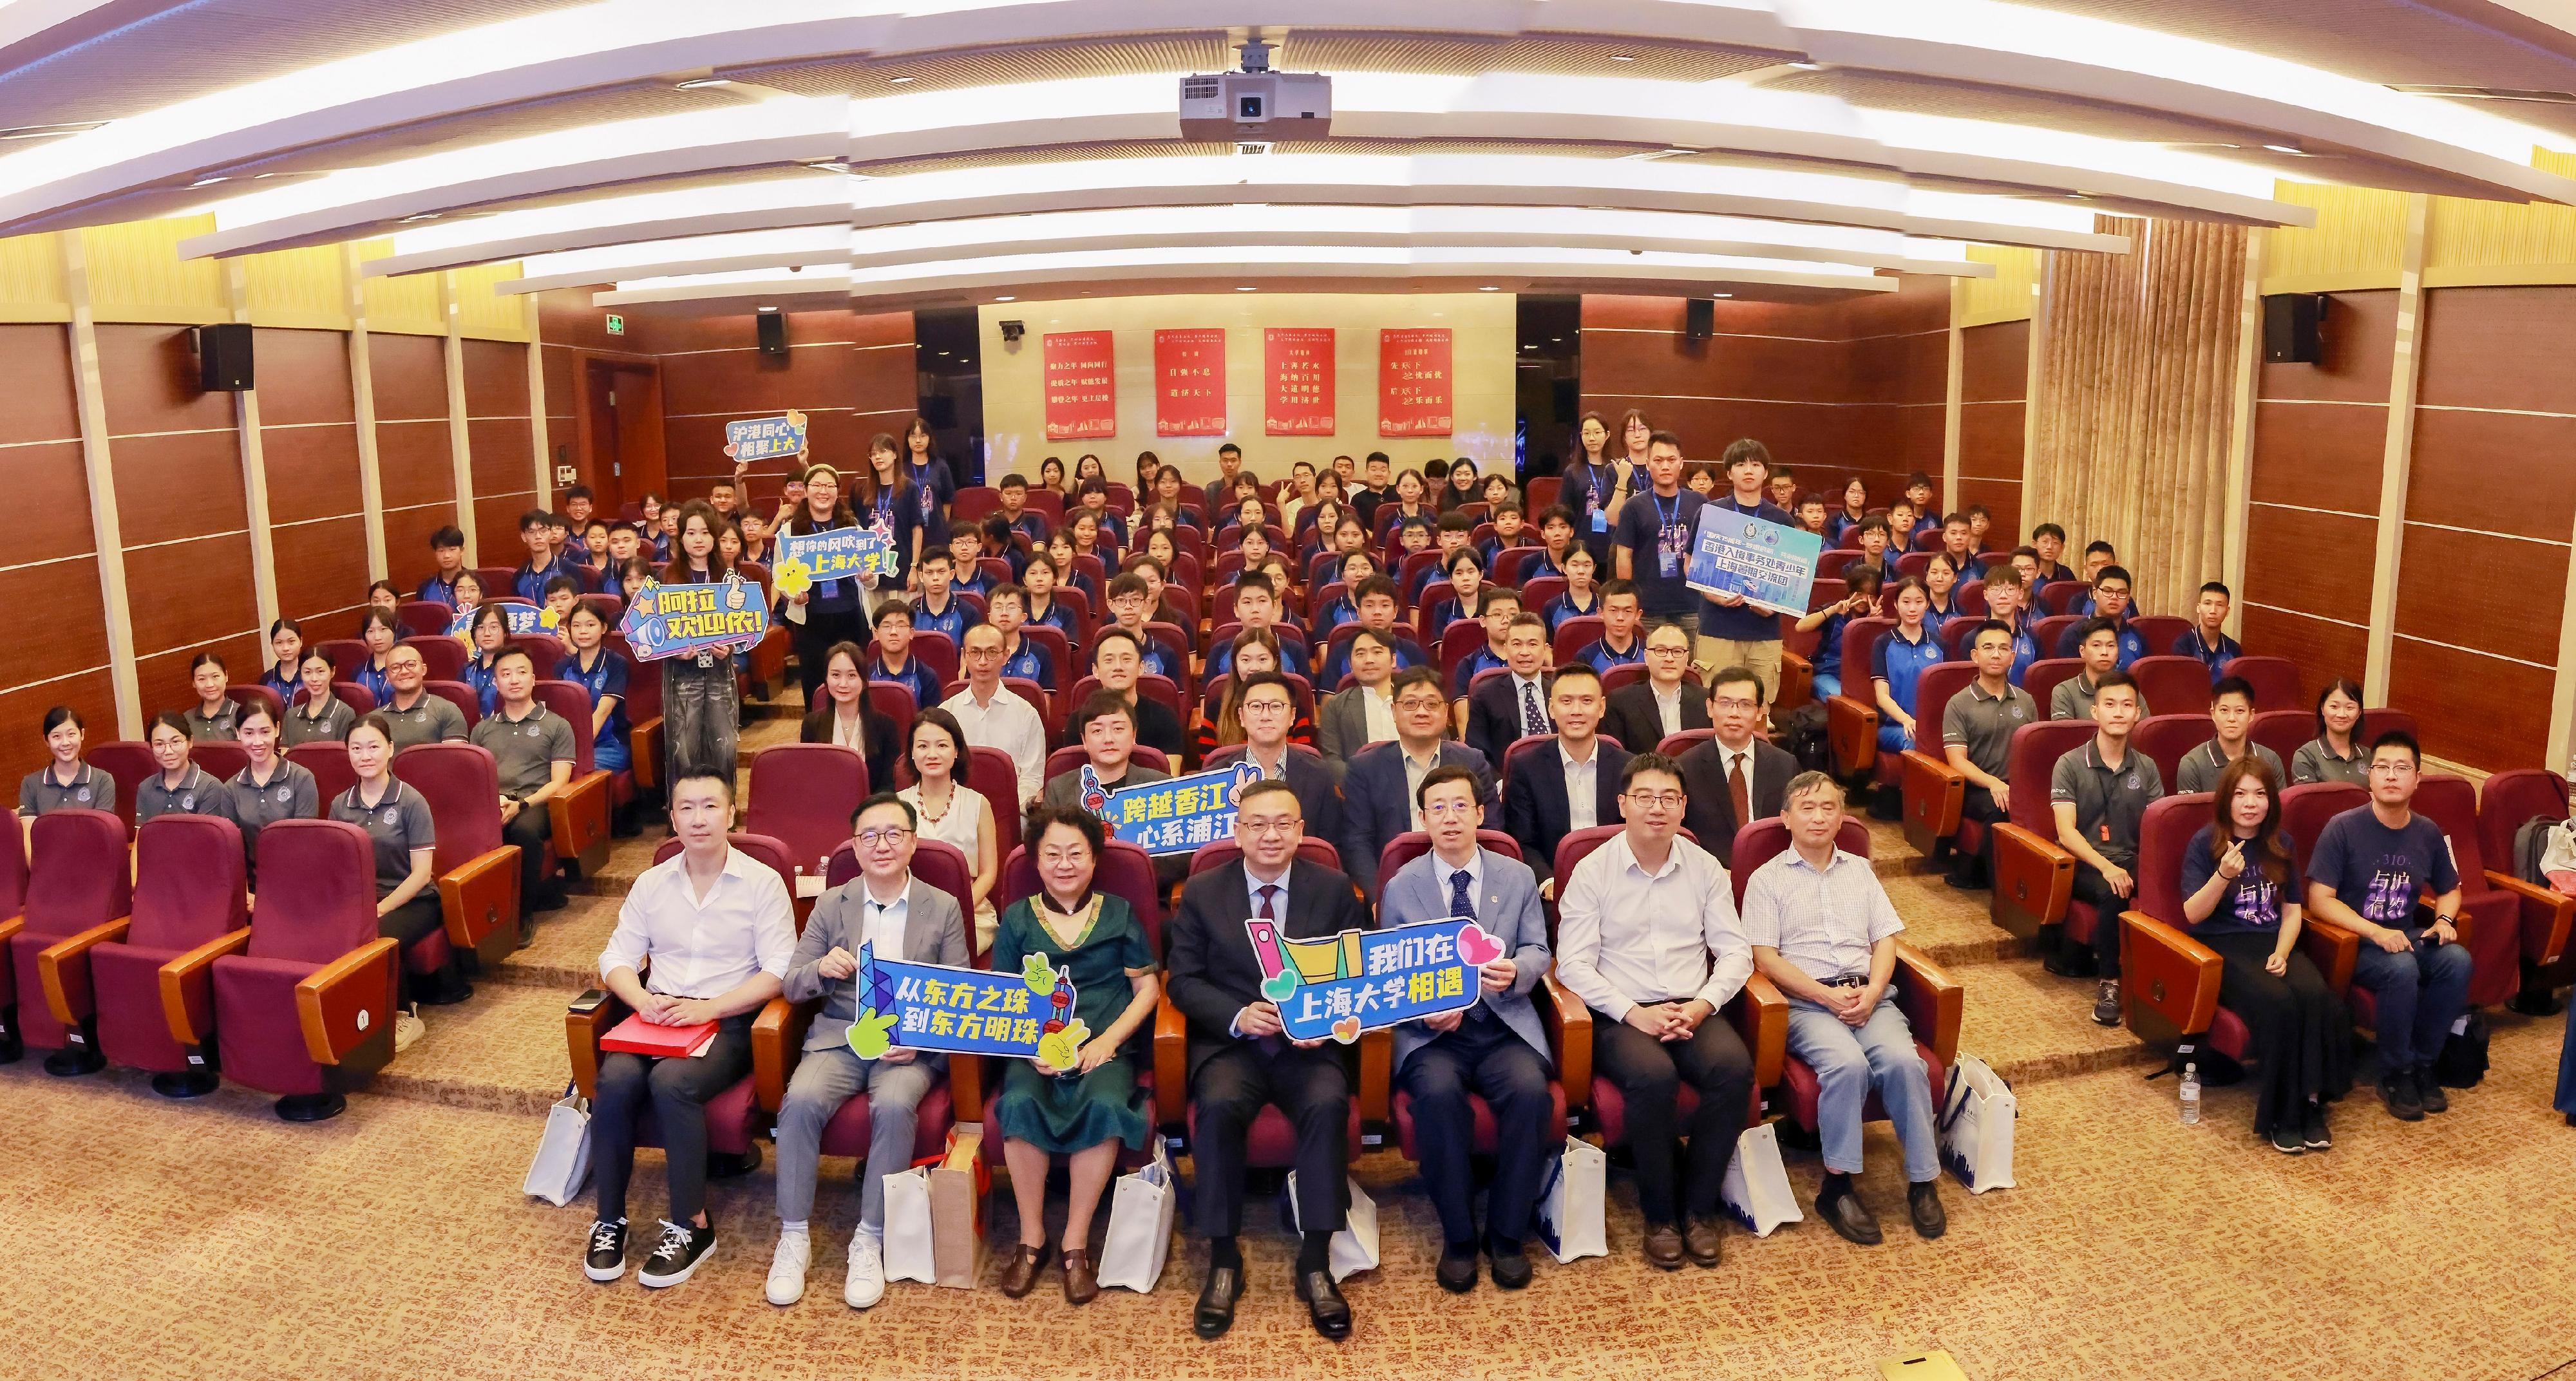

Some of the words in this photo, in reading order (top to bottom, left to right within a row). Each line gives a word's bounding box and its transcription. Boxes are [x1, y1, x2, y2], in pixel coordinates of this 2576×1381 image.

[733, 422, 790, 441] 沪港同心
[741, 437, 795, 457] 相聚上大
[789, 535, 876, 557] 想你的风吹到了
[1704, 541, 1806, 576] 香港入境事务处青少年
[810, 552, 881, 571] 上海大学
[1717, 558, 1789, 586] 上海暑期交流团
[657, 588, 717, 615] 阿拉
[1122, 782, 1227, 824] 跨越香江
[1137, 813, 1238, 849] 心系浦江
[2368, 869, 2410, 892] 与沪
[2364, 896, 2405, 917] 有约
[1368, 933, 1454, 976] 我们在
[895, 976, 1030, 1014] 从东方之珠
[1294, 966, 1464, 1023] 上海大学相遇
[902, 1006, 1039, 1044] 到东方明珠
